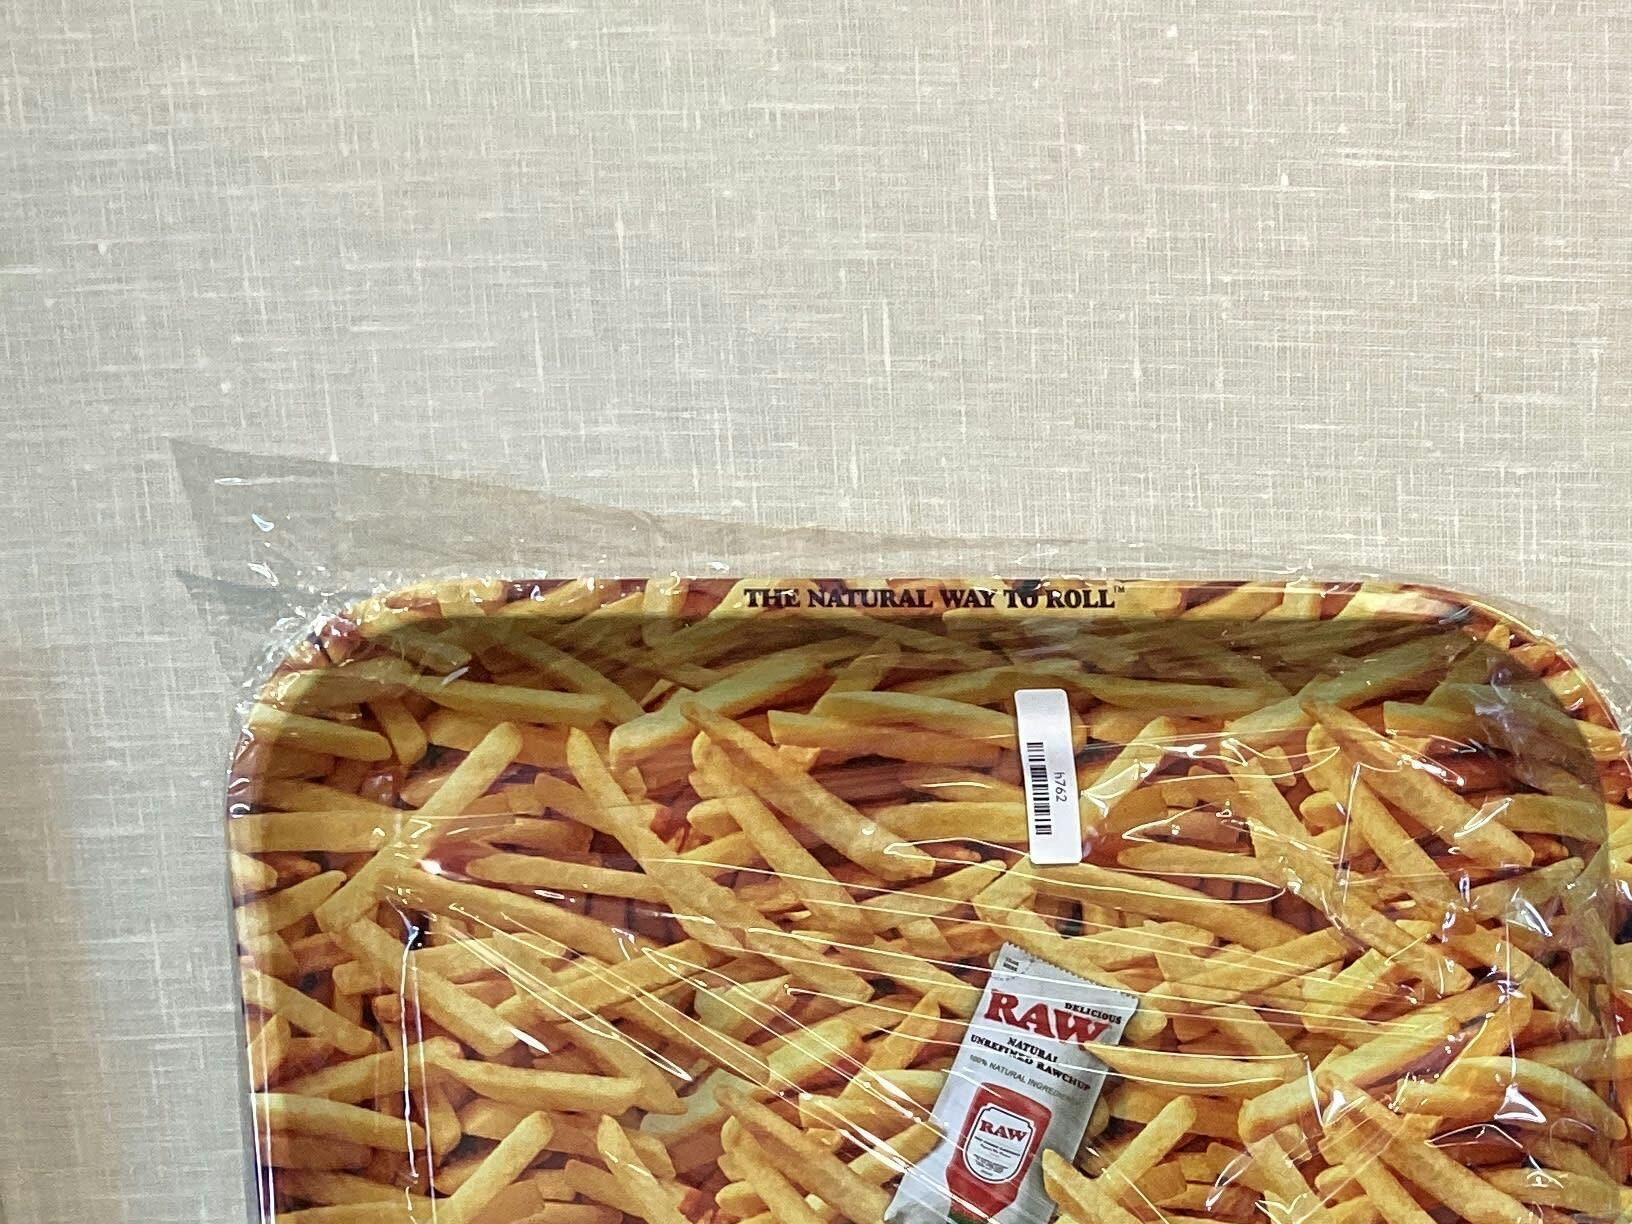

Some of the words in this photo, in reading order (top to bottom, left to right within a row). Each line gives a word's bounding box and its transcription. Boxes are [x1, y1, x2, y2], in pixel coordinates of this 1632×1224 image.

[744, 588, 802, 609] THE
[807, 588, 934, 609] NATURAL
[939, 588, 997, 609] WAY
[1003, 588, 1039, 609] TO
[984, 988, 1112, 1046] RAW
[1064, 1002, 1122, 1025] DELICIOUS
[989, 1062, 1026, 1083] NATURAL
[1036, 1062, 1092, 1091] RAWCHUP
[979, 1119, 1028, 1142] RAW
